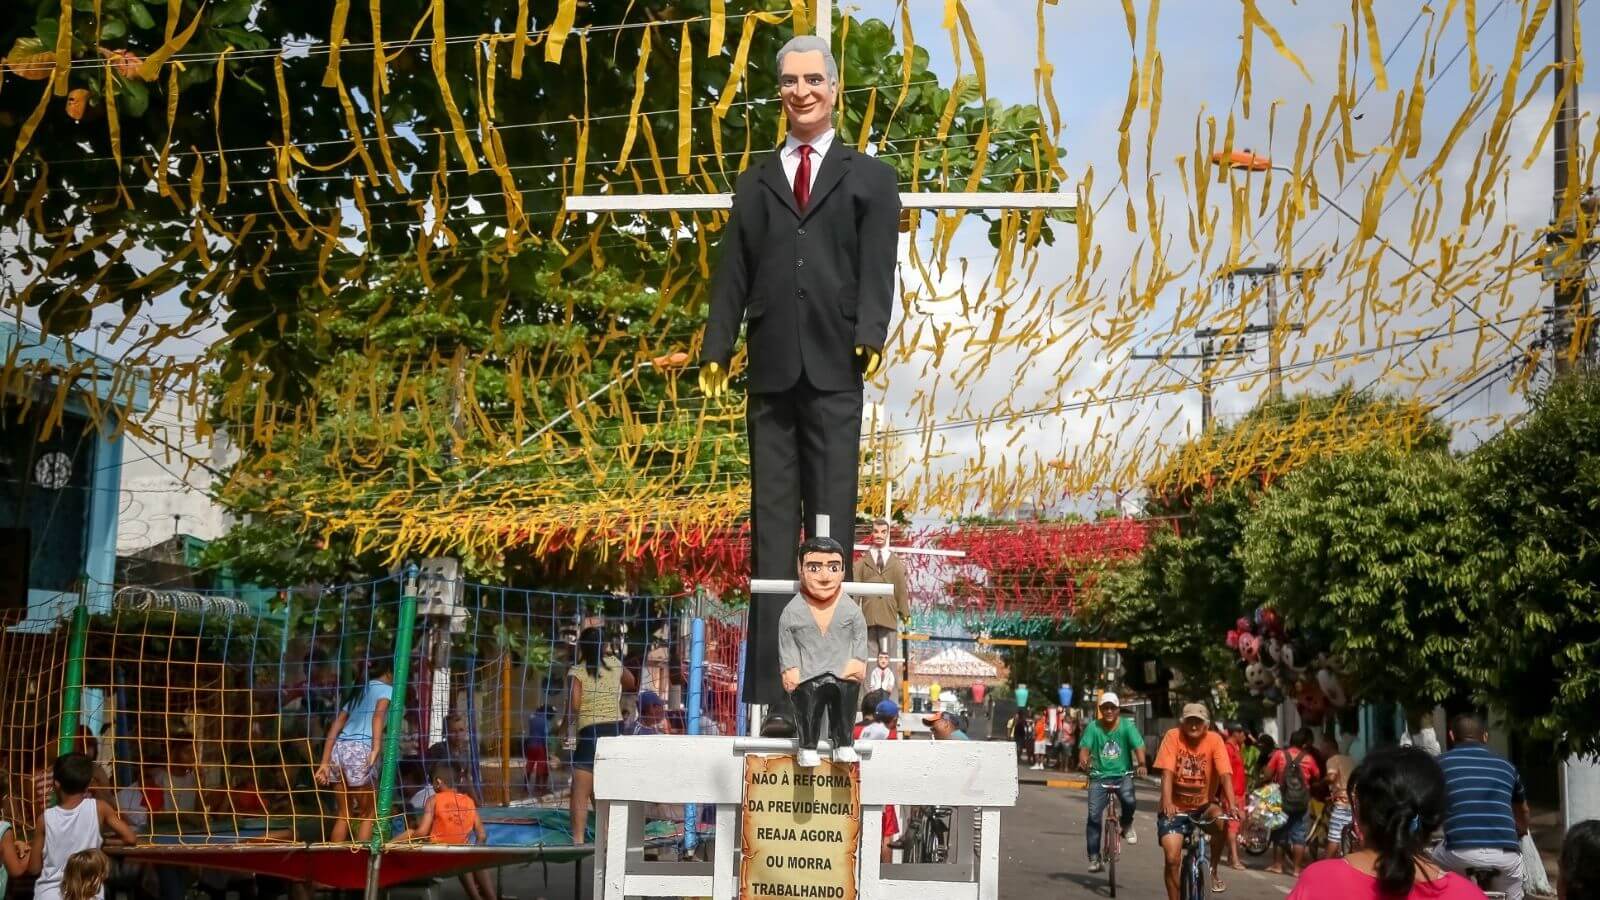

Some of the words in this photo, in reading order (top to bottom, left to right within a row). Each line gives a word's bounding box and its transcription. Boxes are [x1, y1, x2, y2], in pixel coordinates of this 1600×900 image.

[752, 770, 777, 785] NÃO
[781, 771, 789, 785] À
[794, 774, 851, 788] REFORMA
[748, 800, 764, 812] DA
[768, 800, 854, 815] PREVIDÊNCIA!
[757, 828, 796, 841] REAJA
[800, 830, 842, 842] AGORA
[766, 856, 783, 868] OU
[788, 857, 832, 870] MORRA
[752, 883, 844, 899] TRABALHANDO
